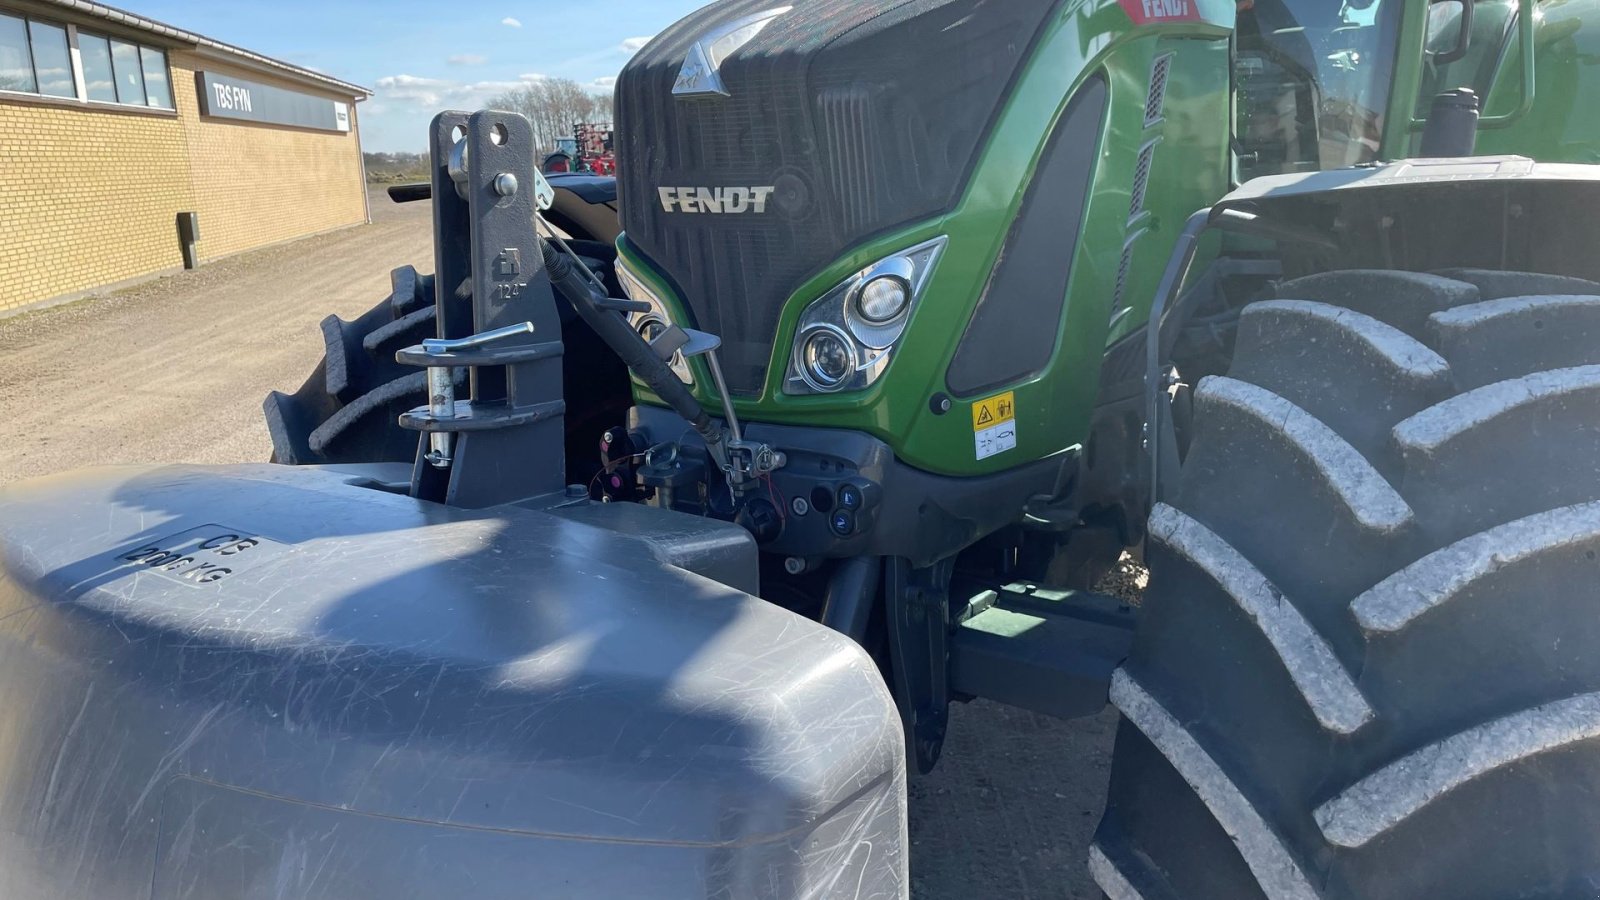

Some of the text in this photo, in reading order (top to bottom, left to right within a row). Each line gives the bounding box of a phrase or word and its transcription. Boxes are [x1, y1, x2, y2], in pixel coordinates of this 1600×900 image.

[213, 82, 252, 112] TBS FYN
[657, 186, 775, 213] FENDT
[178, 562, 232, 583] KG
